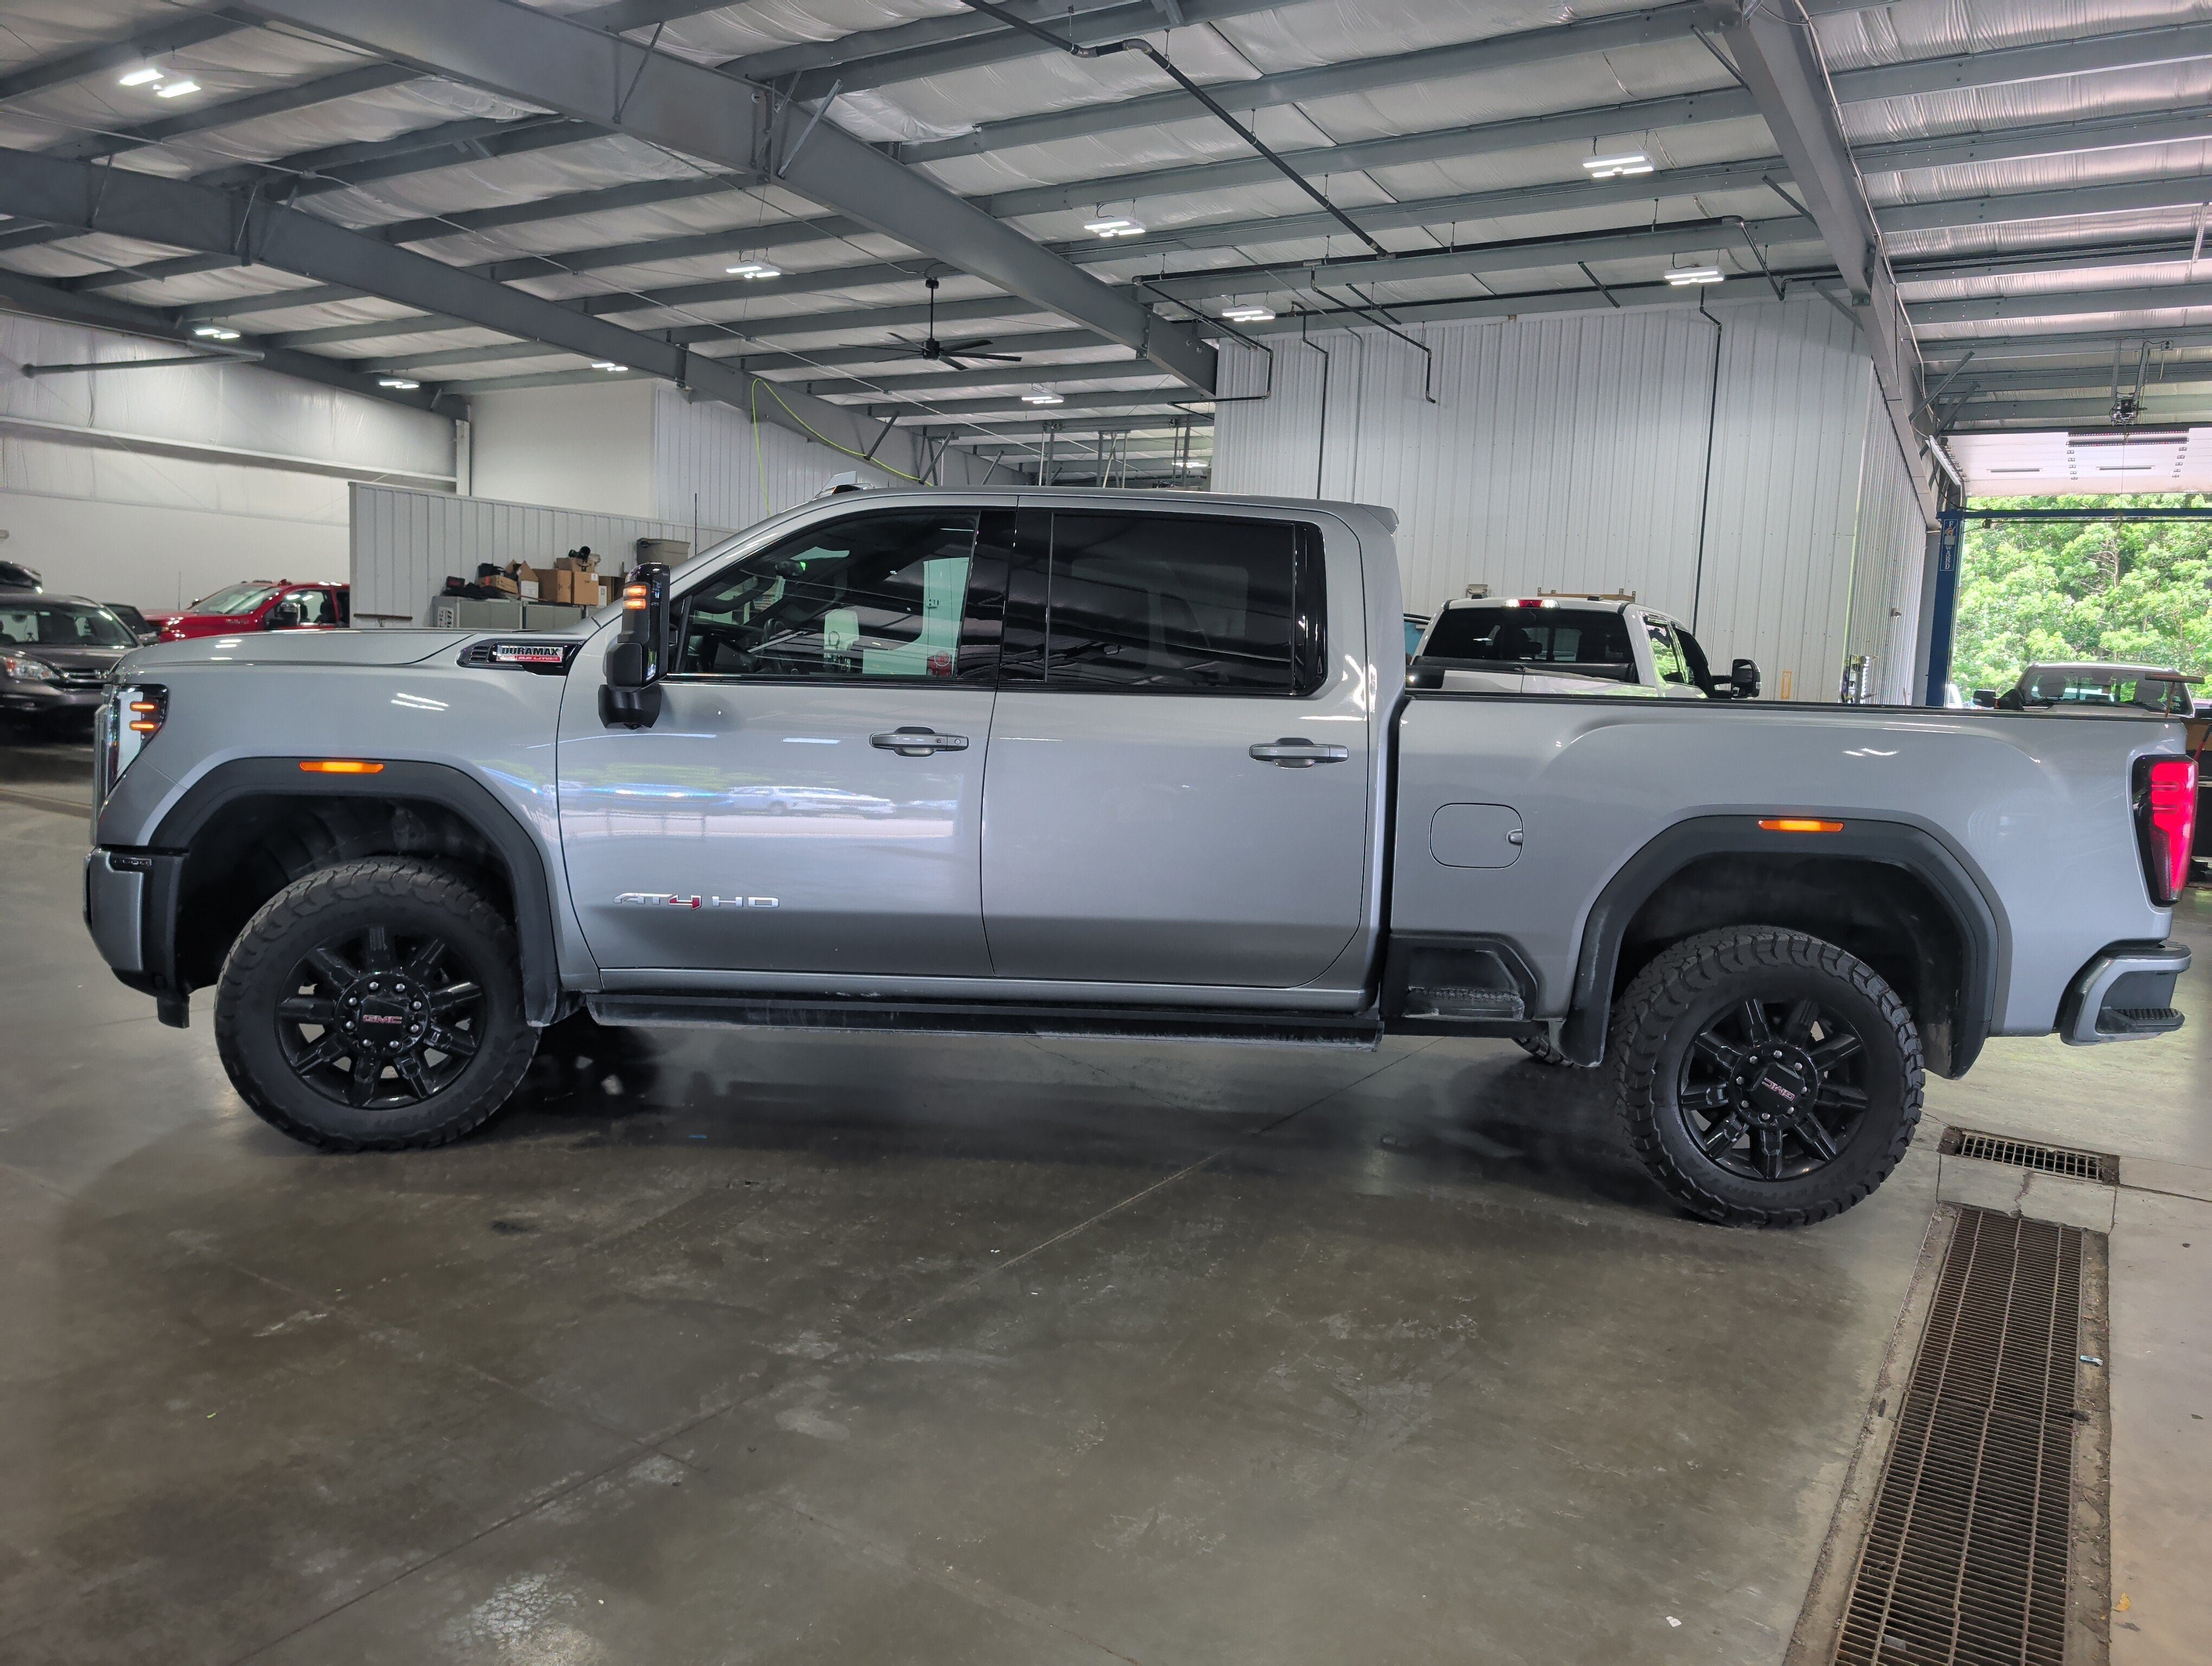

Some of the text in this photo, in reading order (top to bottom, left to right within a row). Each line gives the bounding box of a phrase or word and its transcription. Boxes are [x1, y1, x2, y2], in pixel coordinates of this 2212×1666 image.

[1944, 521, 1954, 570] FWARD
[501, 646, 559, 656] DURAMAX
[613, 892, 780, 911] AT4 HD
[363, 1014, 402, 1024] GMC
[1761, 1077, 1796, 1101] GMC
